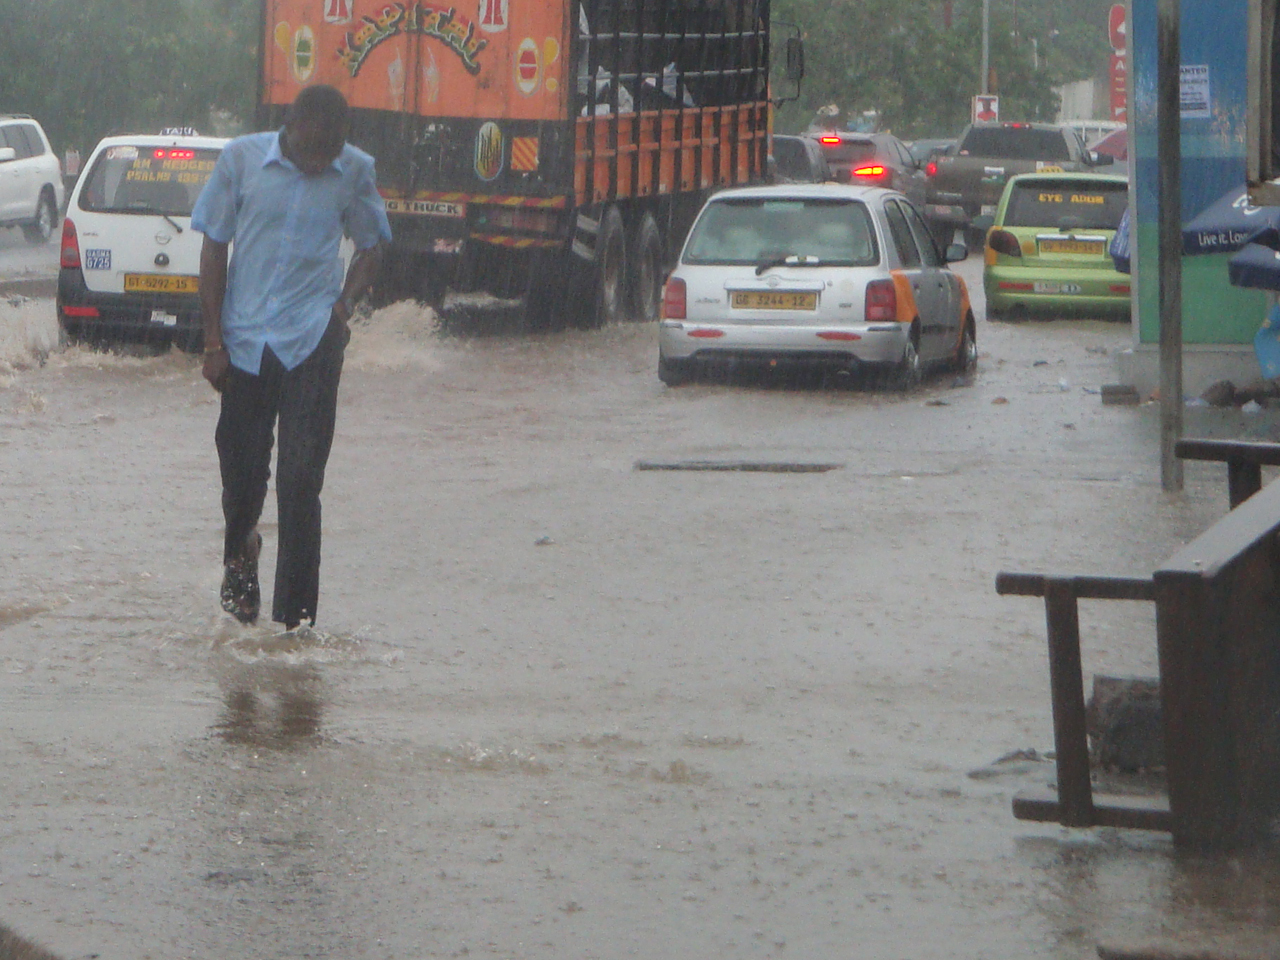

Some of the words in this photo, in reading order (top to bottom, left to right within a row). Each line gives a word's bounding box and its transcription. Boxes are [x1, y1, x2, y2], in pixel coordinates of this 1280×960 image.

[165, 127, 192, 135] TAXI
[405, 201, 458, 214] TRUCK
[1198, 230, 1217, 246] Live
